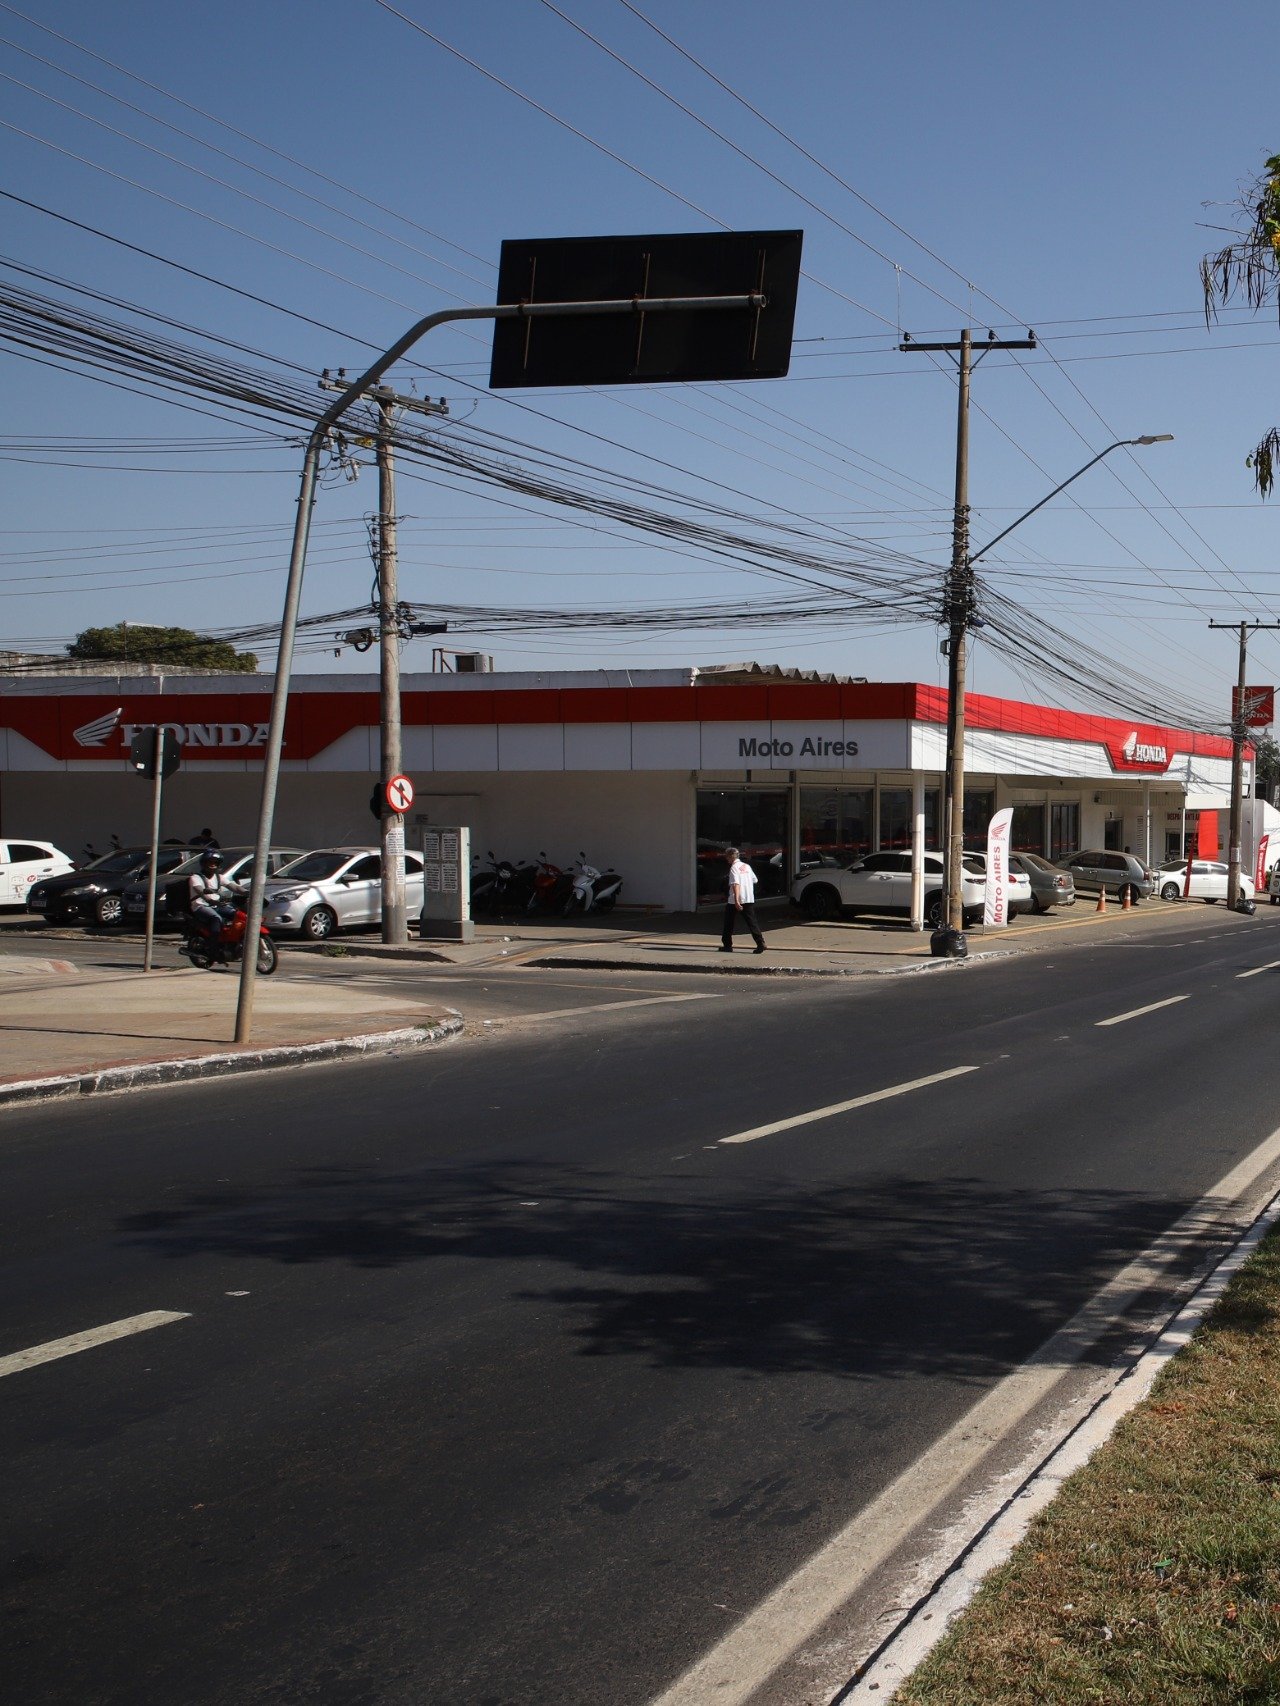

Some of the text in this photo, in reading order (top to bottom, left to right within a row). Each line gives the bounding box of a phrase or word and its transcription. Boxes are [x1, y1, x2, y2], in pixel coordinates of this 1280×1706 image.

[739, 737, 858, 757] Moto Aires
[1136, 744, 1167, 762] HONDA
[993, 846, 1004, 923] MOTO AIRES
